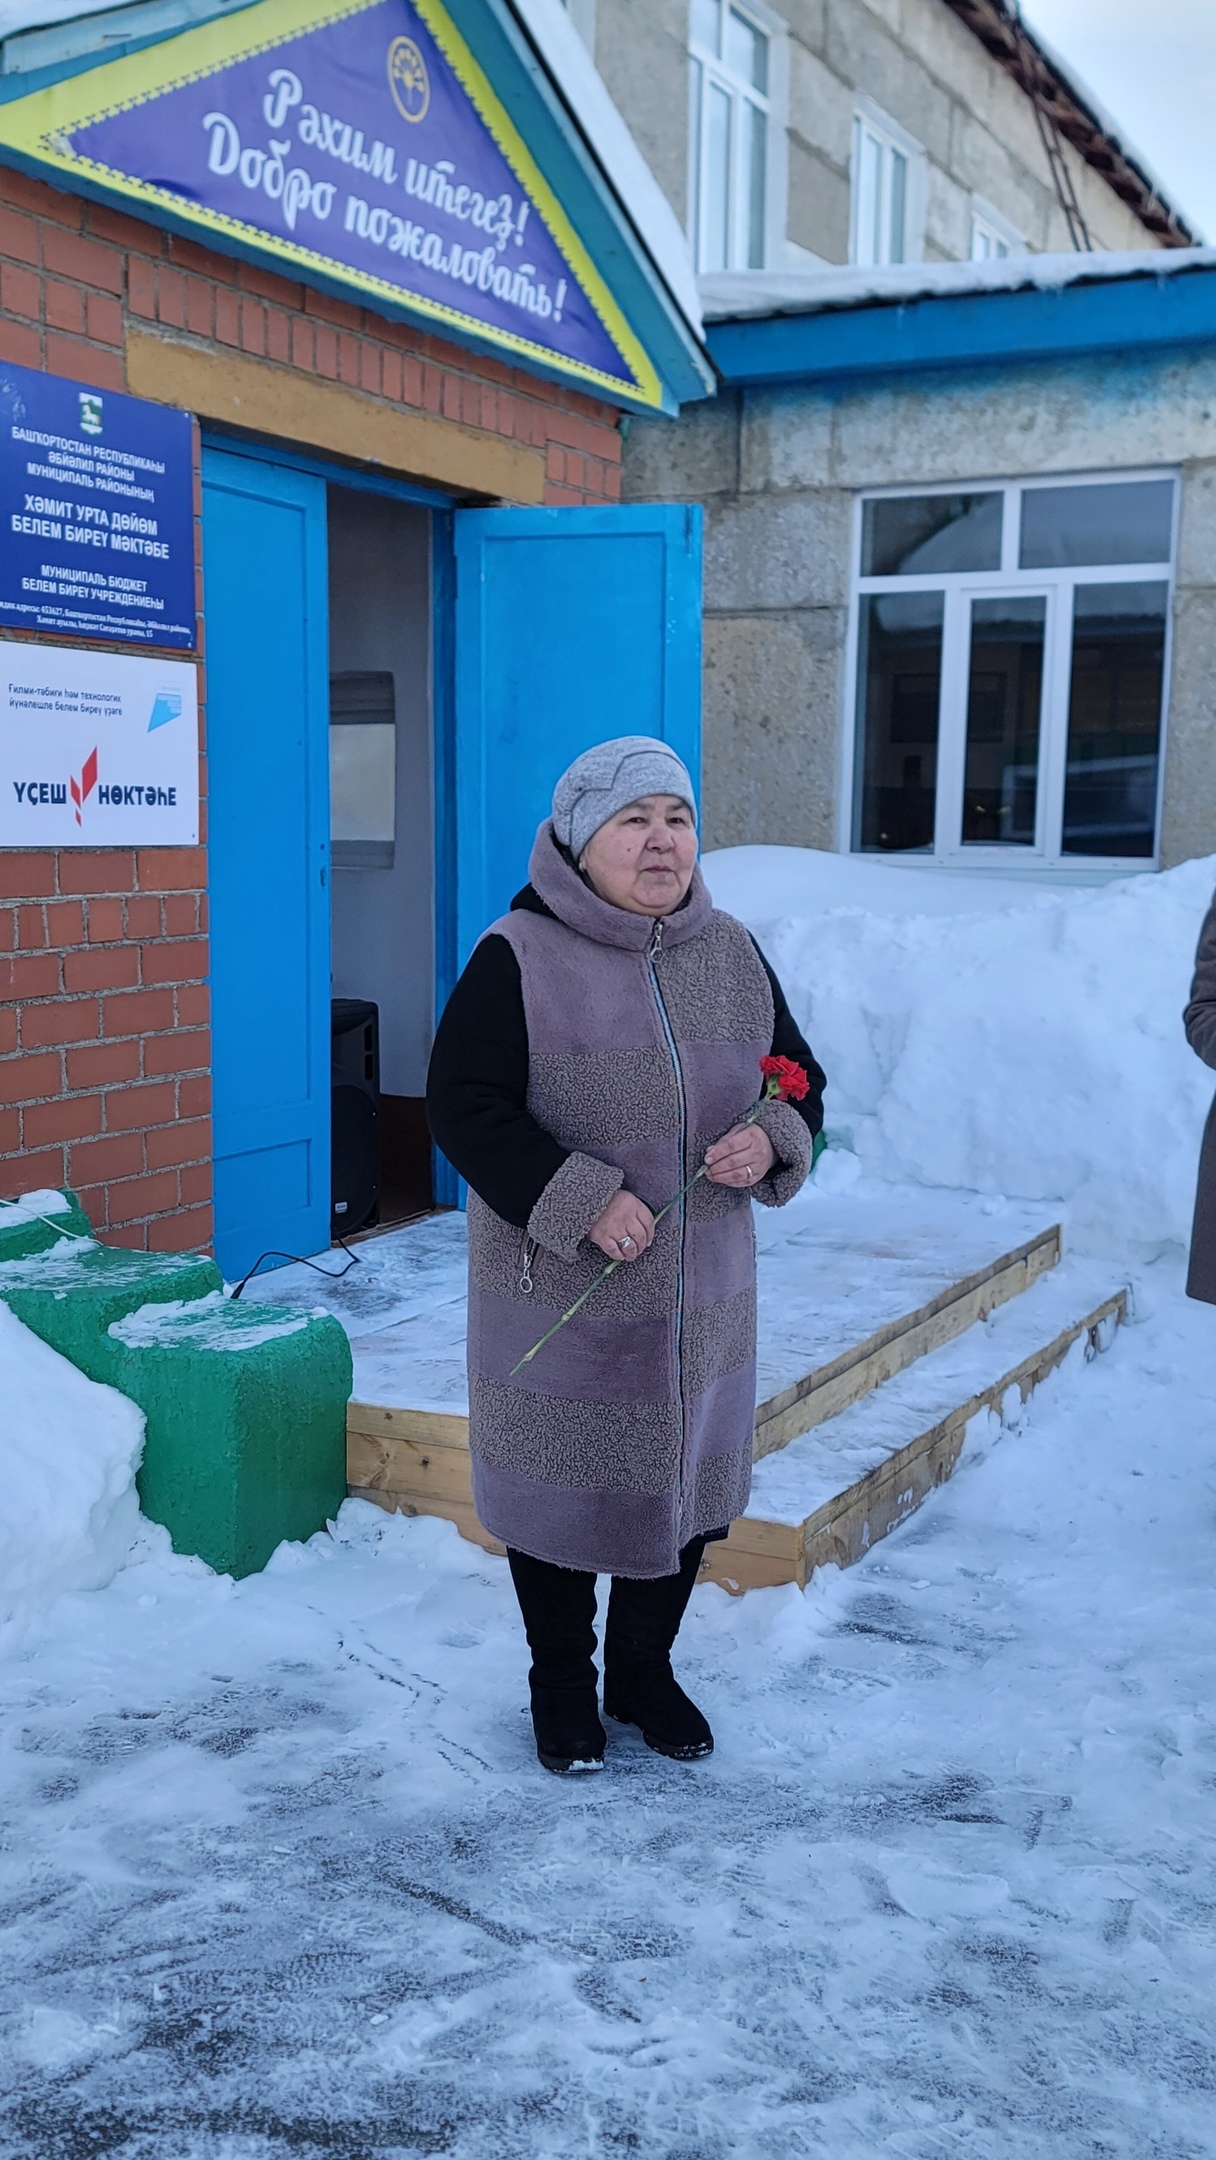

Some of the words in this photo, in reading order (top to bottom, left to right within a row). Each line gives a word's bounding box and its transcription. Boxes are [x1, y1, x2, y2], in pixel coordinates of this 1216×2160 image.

[263, 68, 398, 184] Рәхим
[404, 159, 530, 251] итегеҙ!
[202, 112, 337, 231] Добро
[344, 196, 567, 322] пожаловать!
[12, 426, 92, 456] БАШҠОРТОСТАН
[93, 445, 166, 474] РЕСПУБЛИКАҺЫ
[48, 451, 94, 473] ӘБЙӘЛИЛ
[95, 461, 135, 482] РАЙОНЫ
[27, 462, 94, 488] МУНИЦИПАЛЬ
[95, 477, 155, 503] РАЙОНЫНЫҢ
[24, 493, 74, 519] ХӘМИТ
[75, 504, 109, 527] УРТА
[111, 512, 158, 536] ДӨЙӨМ
[12, 514, 62, 539] БЕЛЕМ
[65, 524, 109, 548] БИРЕҮ
[111, 533, 170, 560] МӘКТӘБЕ
[22, 577, 57, 594] БЕЛЕМ
[58, 582, 89, 598] БИРЕҮ
[90, 587, 165, 610] УЧРЕЖДЕНИЕҺЫ
[41, 564, 107, 586] МУНИЦИПАЛЬ
[108, 575, 148, 592] БЮДЖЕТ
[9, 697, 53, 711] йүнәлешле
[55, 701, 79, 712] белем
[80, 703, 102, 717] биреү
[64, 688, 79, 699] һәм
[81, 691, 122, 703] технологик
[13, 782, 67, 806] ҮҪЕШ
[98, 784, 177, 806] НӨКТӘҺЕ
